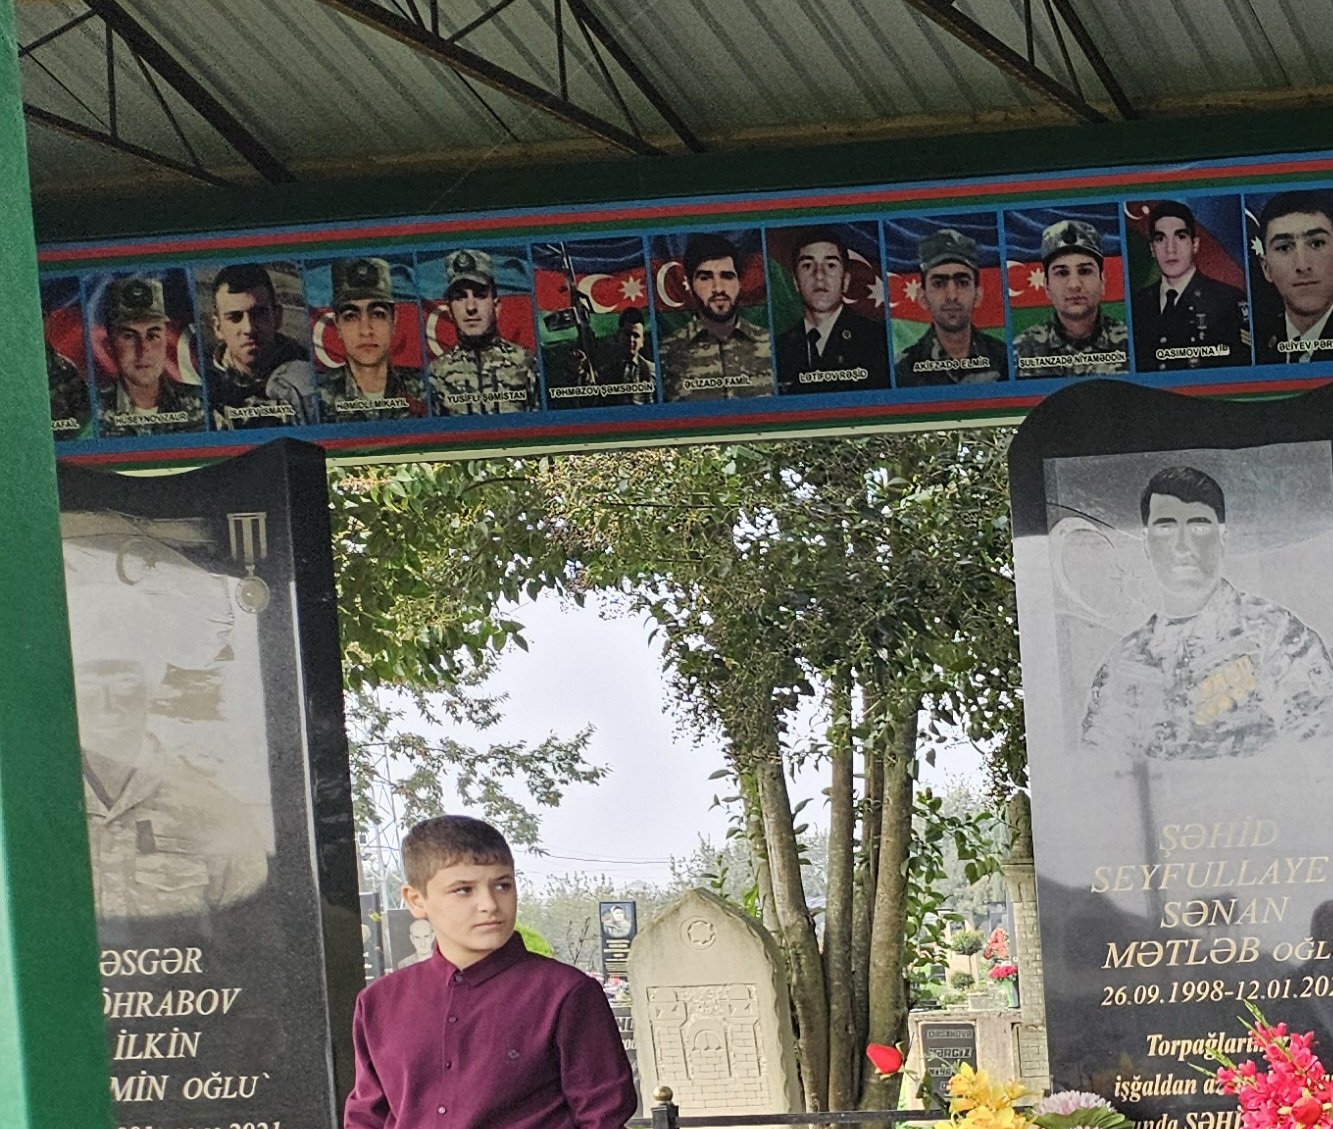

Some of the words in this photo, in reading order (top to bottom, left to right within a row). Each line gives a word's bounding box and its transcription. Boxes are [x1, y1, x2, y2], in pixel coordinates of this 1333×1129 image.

[1279, 340, 1311, 351] ƏLİYEV
[1159, 815, 1281, 857] ŞƏHİD
[1161, 896, 1291, 929] SƏNAN
[100, 947, 203, 977] ƏSGƏR
[1101, 936, 1261, 970] MƏTLƏB
[113, 1027, 202, 1061] İLKİN
[110, 1070, 169, 1102] MİN
[1114, 1072, 1197, 1103] işğaldan
